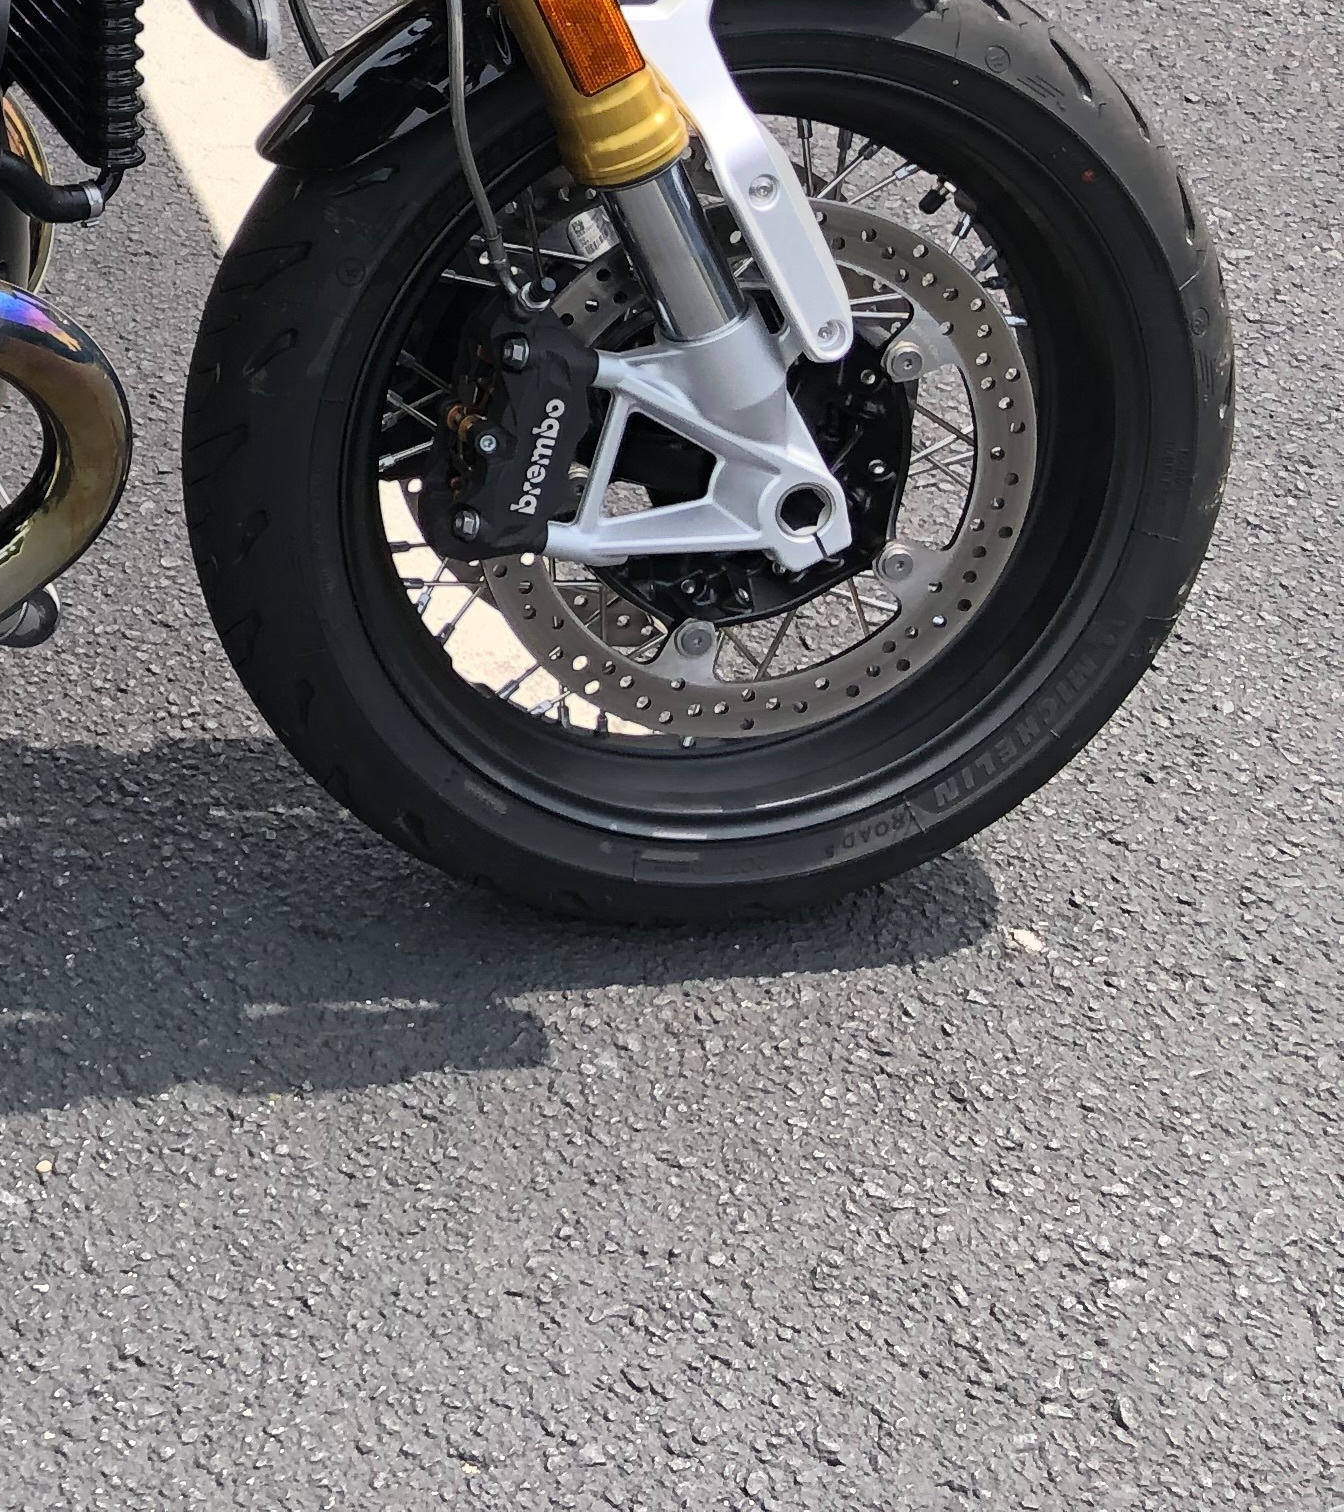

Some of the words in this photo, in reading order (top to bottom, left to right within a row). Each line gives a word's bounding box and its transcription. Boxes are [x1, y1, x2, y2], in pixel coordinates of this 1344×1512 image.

[509, 398, 566, 515] brembo
[932, 654, 1100, 809] MICHELIN
[841, 808, 912, 848] ROAD
